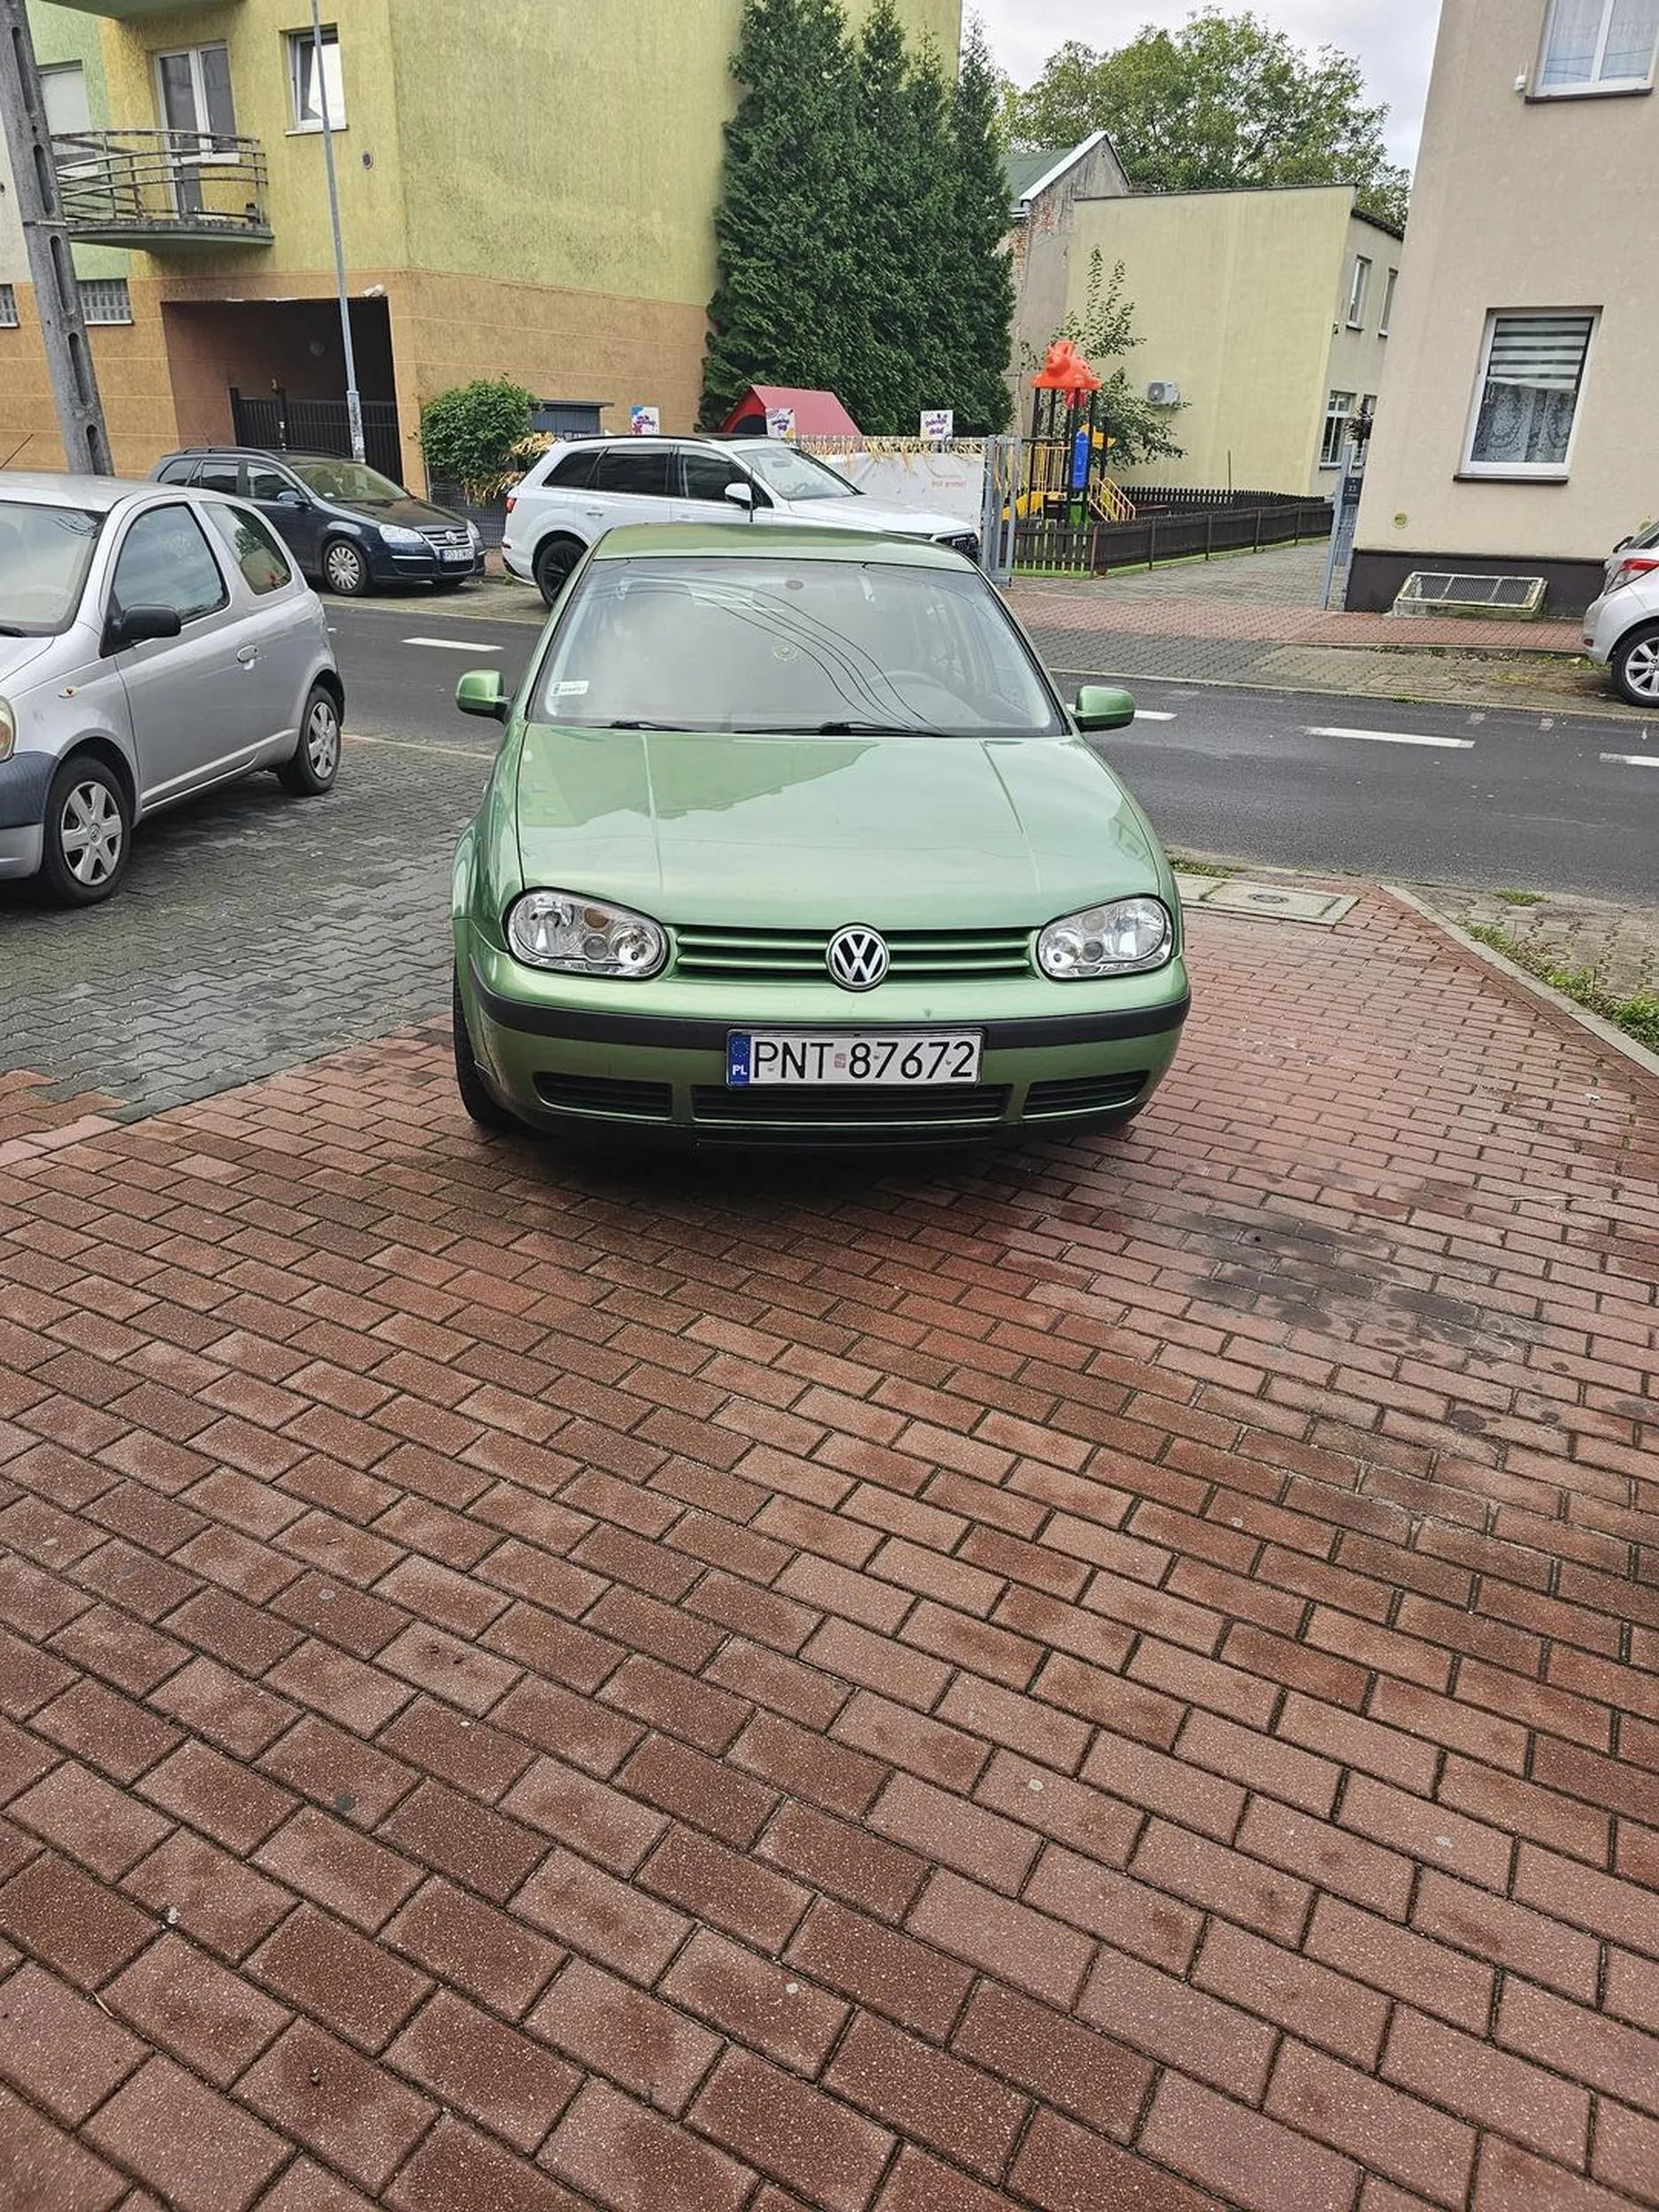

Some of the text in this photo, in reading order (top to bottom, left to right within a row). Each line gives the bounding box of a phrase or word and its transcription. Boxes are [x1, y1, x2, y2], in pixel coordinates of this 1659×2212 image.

[830, 929, 886, 987] VW
[732, 1064, 748, 1076] PL
[753, 1041, 975, 1079] PNT 87672
